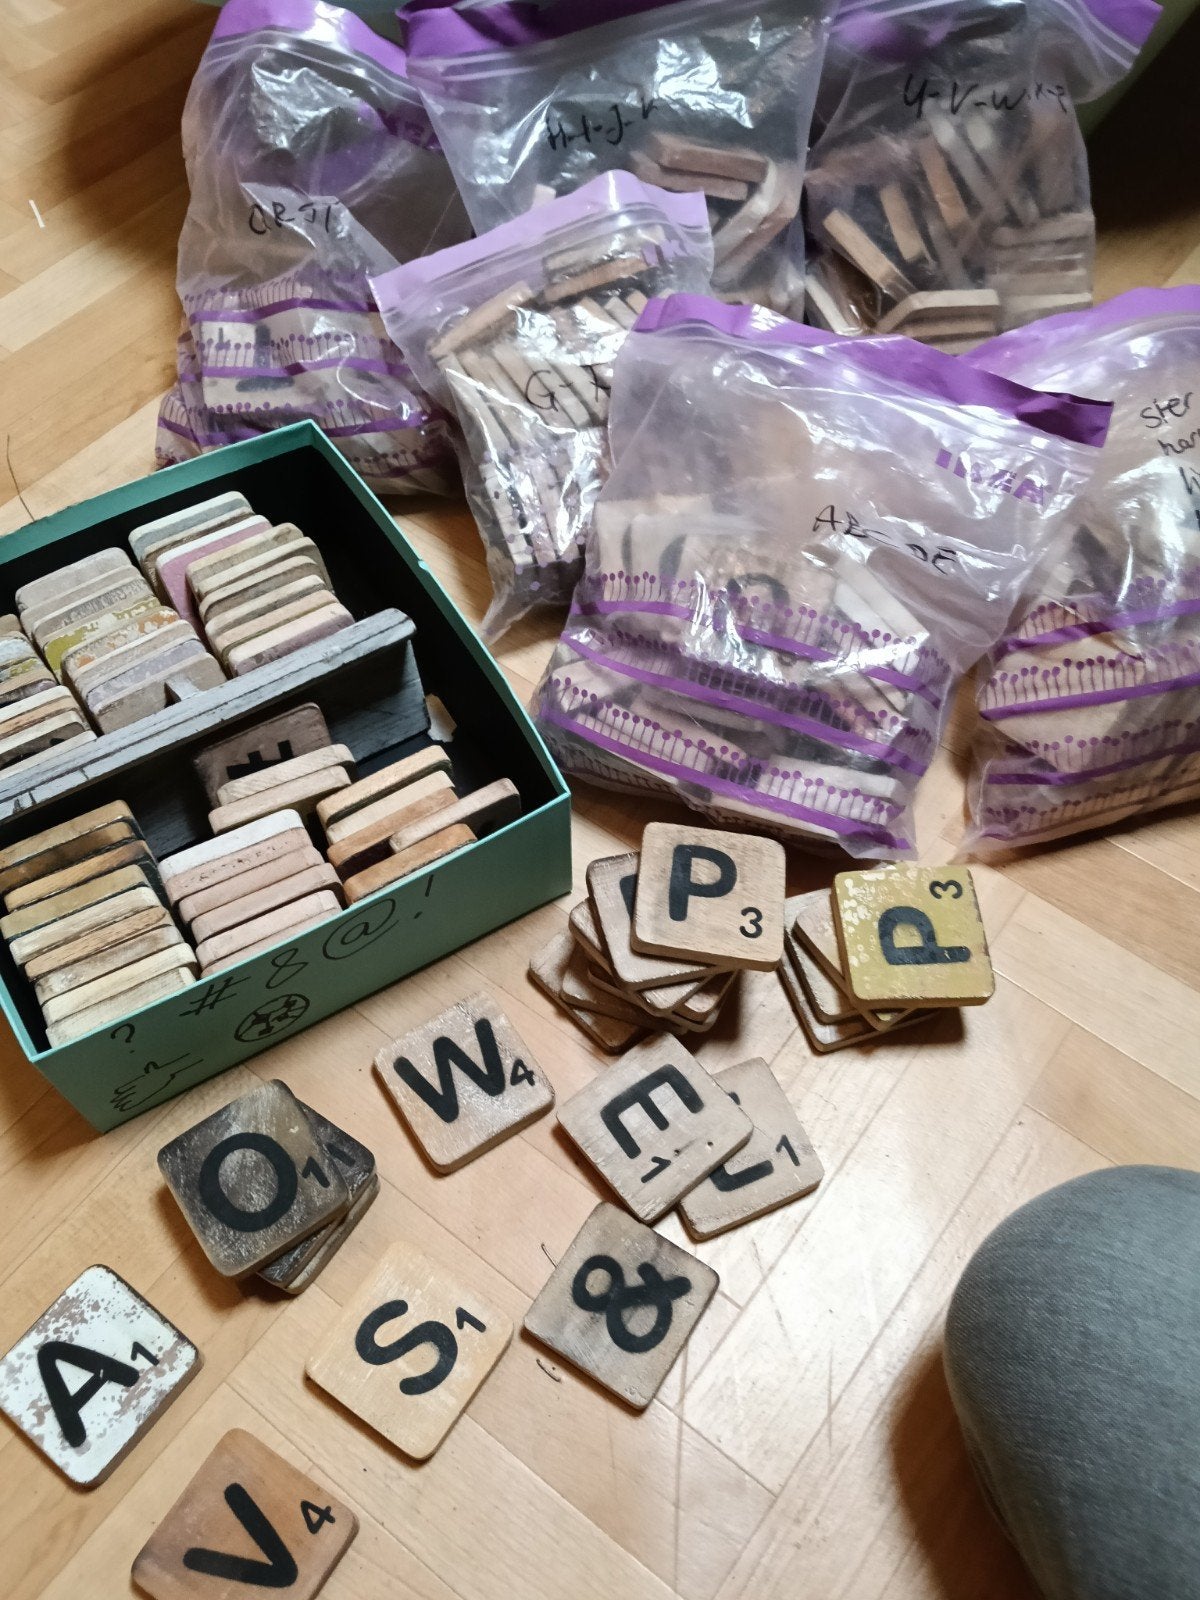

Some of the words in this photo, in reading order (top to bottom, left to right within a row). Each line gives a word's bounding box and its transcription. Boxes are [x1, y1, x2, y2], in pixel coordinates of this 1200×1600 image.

[669, 844, 738, 922] P
[739, 906, 763, 939] 3
[878, 905, 971, 966] P
[929, 879, 963, 900] 3
[393, 1018, 506, 1124] W
[510, 1058, 536, 1087] 4
[600, 1063, 705, 1159] E
[200, 1132, 298, 1232] O
[302, 1155, 331, 1189] 1
[640, 1156, 672, 1184] 1
[775, 1134, 801, 1167] 1
[355, 1299, 459, 1396] S
[456, 1306, 487, 1334] 1
[572, 1254, 693, 1354] &
[37, 1341, 140, 1449] A
[131, 1341, 160, 1366] 1
[183, 1482, 298, 1588] V
[300, 1500, 336, 1535] 4
